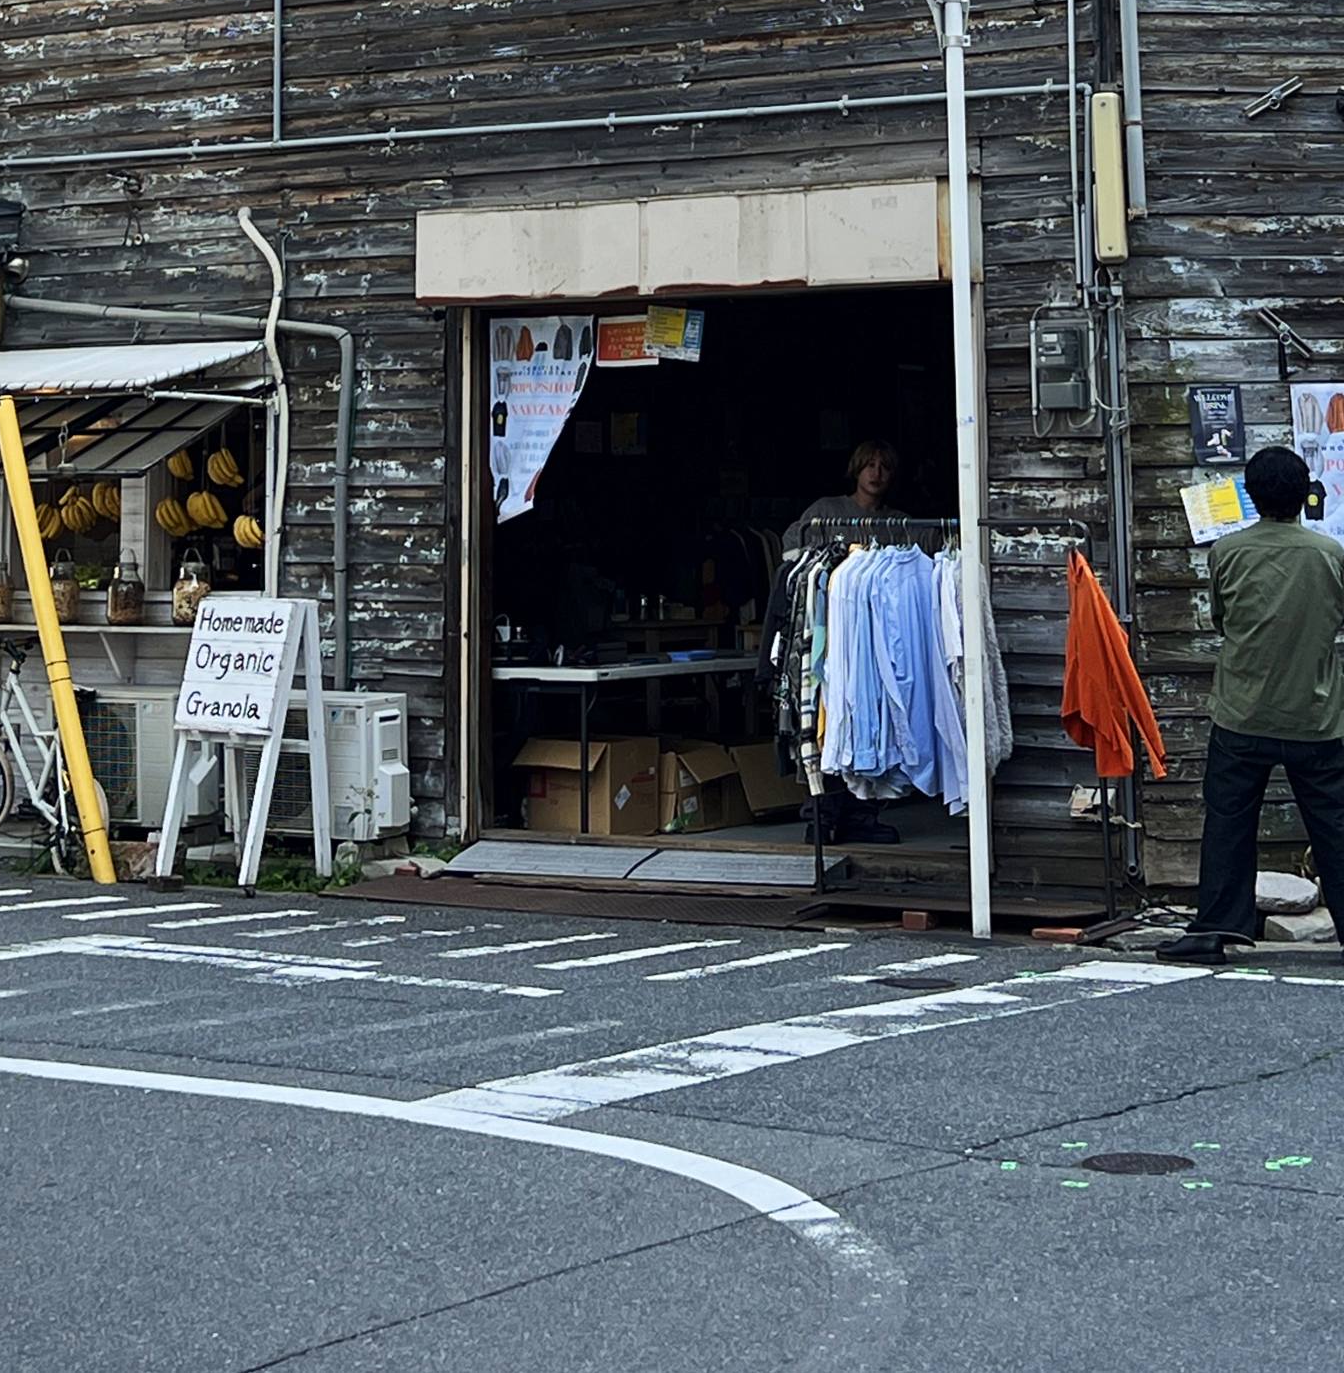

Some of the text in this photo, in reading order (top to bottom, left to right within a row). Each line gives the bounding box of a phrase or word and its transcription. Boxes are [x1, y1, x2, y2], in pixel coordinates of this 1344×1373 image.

[199, 606, 284, 635] Homemade
[195, 643, 274, 680] Organic
[186, 690, 261, 719] Granola
